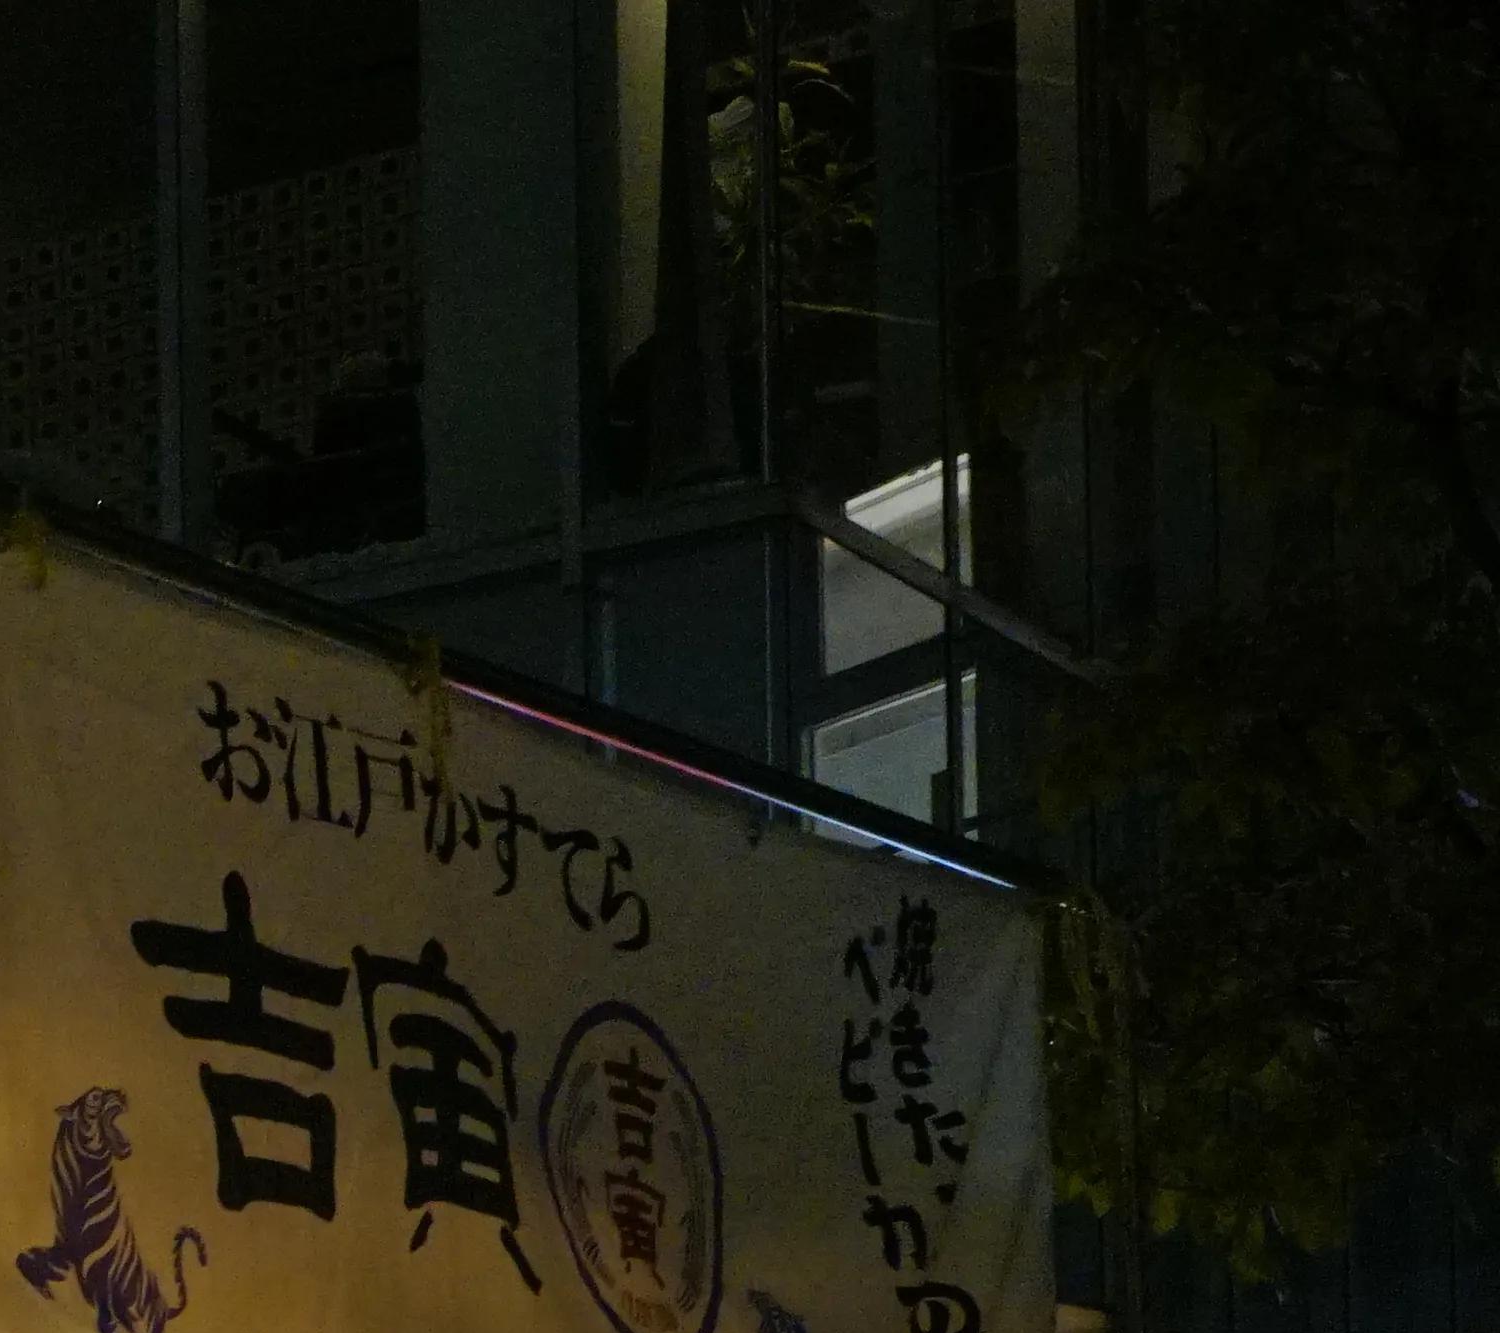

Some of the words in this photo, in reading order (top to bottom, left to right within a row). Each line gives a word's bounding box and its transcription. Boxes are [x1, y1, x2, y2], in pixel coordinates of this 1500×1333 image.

[196, 681, 653, 953] お江戸かすてら
[130, 870, 541, 1294] 吉寅
